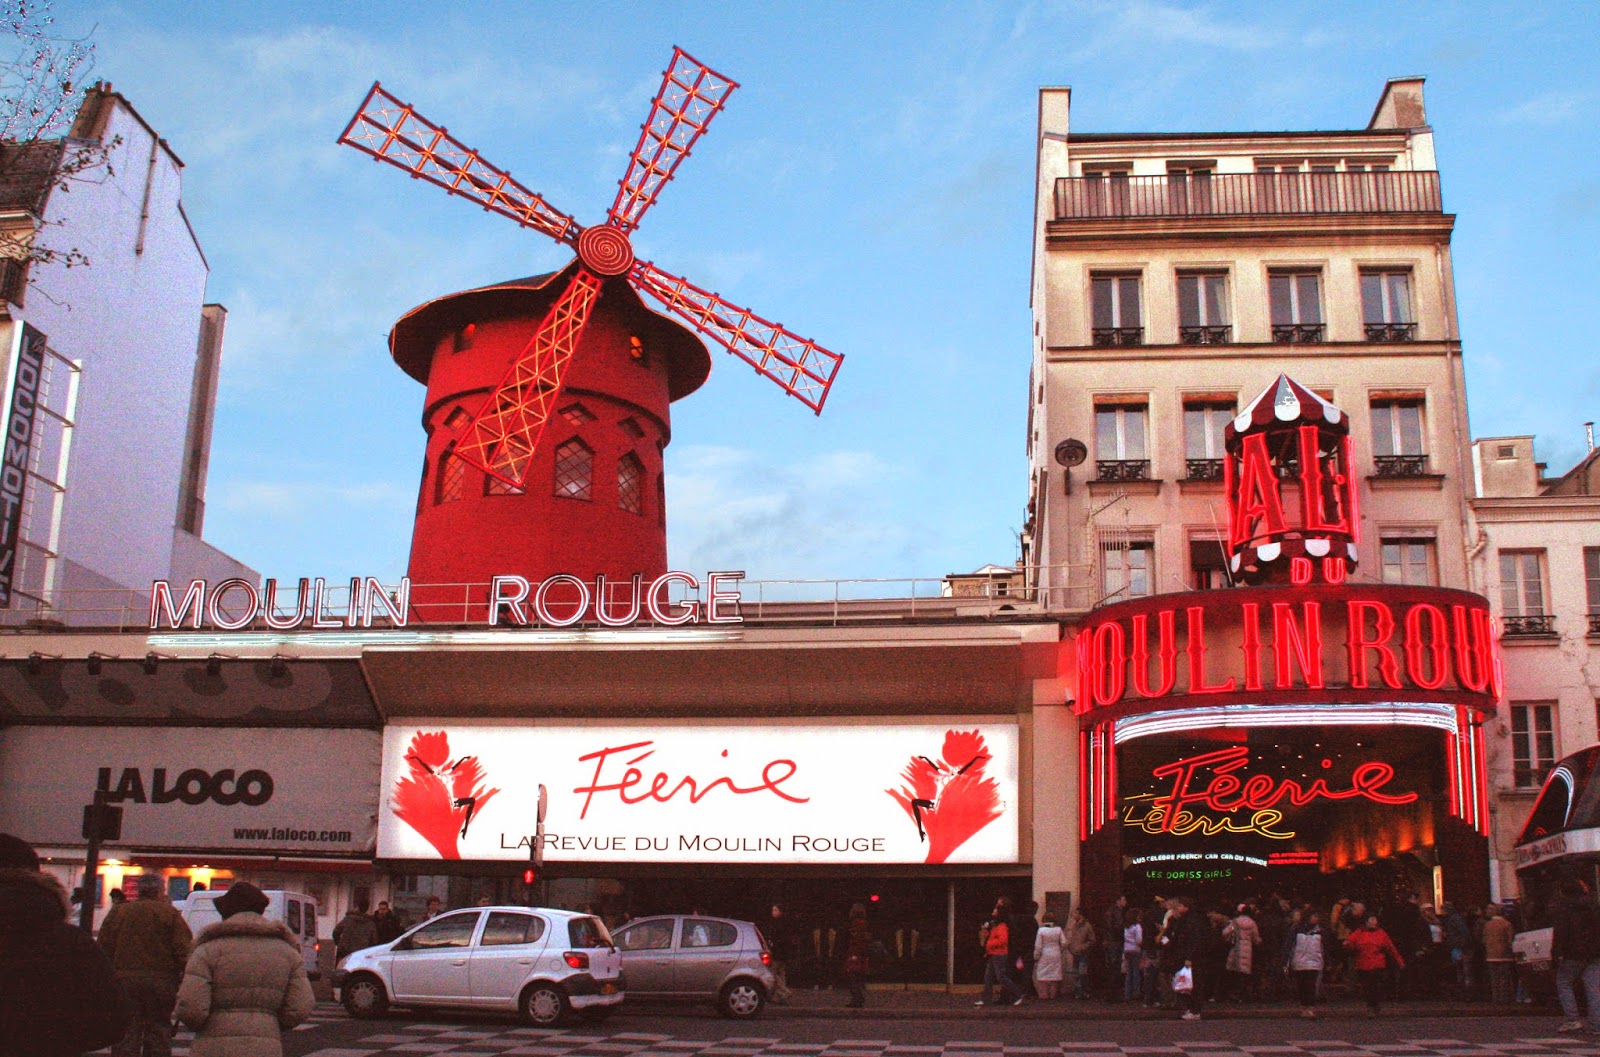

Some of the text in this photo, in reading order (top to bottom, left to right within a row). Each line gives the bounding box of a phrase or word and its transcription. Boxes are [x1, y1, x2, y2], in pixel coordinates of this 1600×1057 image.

[1224, 426, 1350, 558] AL
[149, 570, 746, 630] MOULIN ROUGE
[1290, 557, 1347, 584] DU
[1347, 600, 1504, 699] ROUG
[573, 740, 811, 820] Féerie
[1153, 747, 1419, 833] Féerie
[233, 827, 351, 843] www.laloco.com
[542, 833, 626, 851] REVUE
[635, 837, 669, 851] DU
[679, 834, 781, 851] MOULIN
[792, 835, 886, 852] ROUGE
[1146, 870, 1163, 879] LES
[1203, 869, 1232, 879] GIRLS
